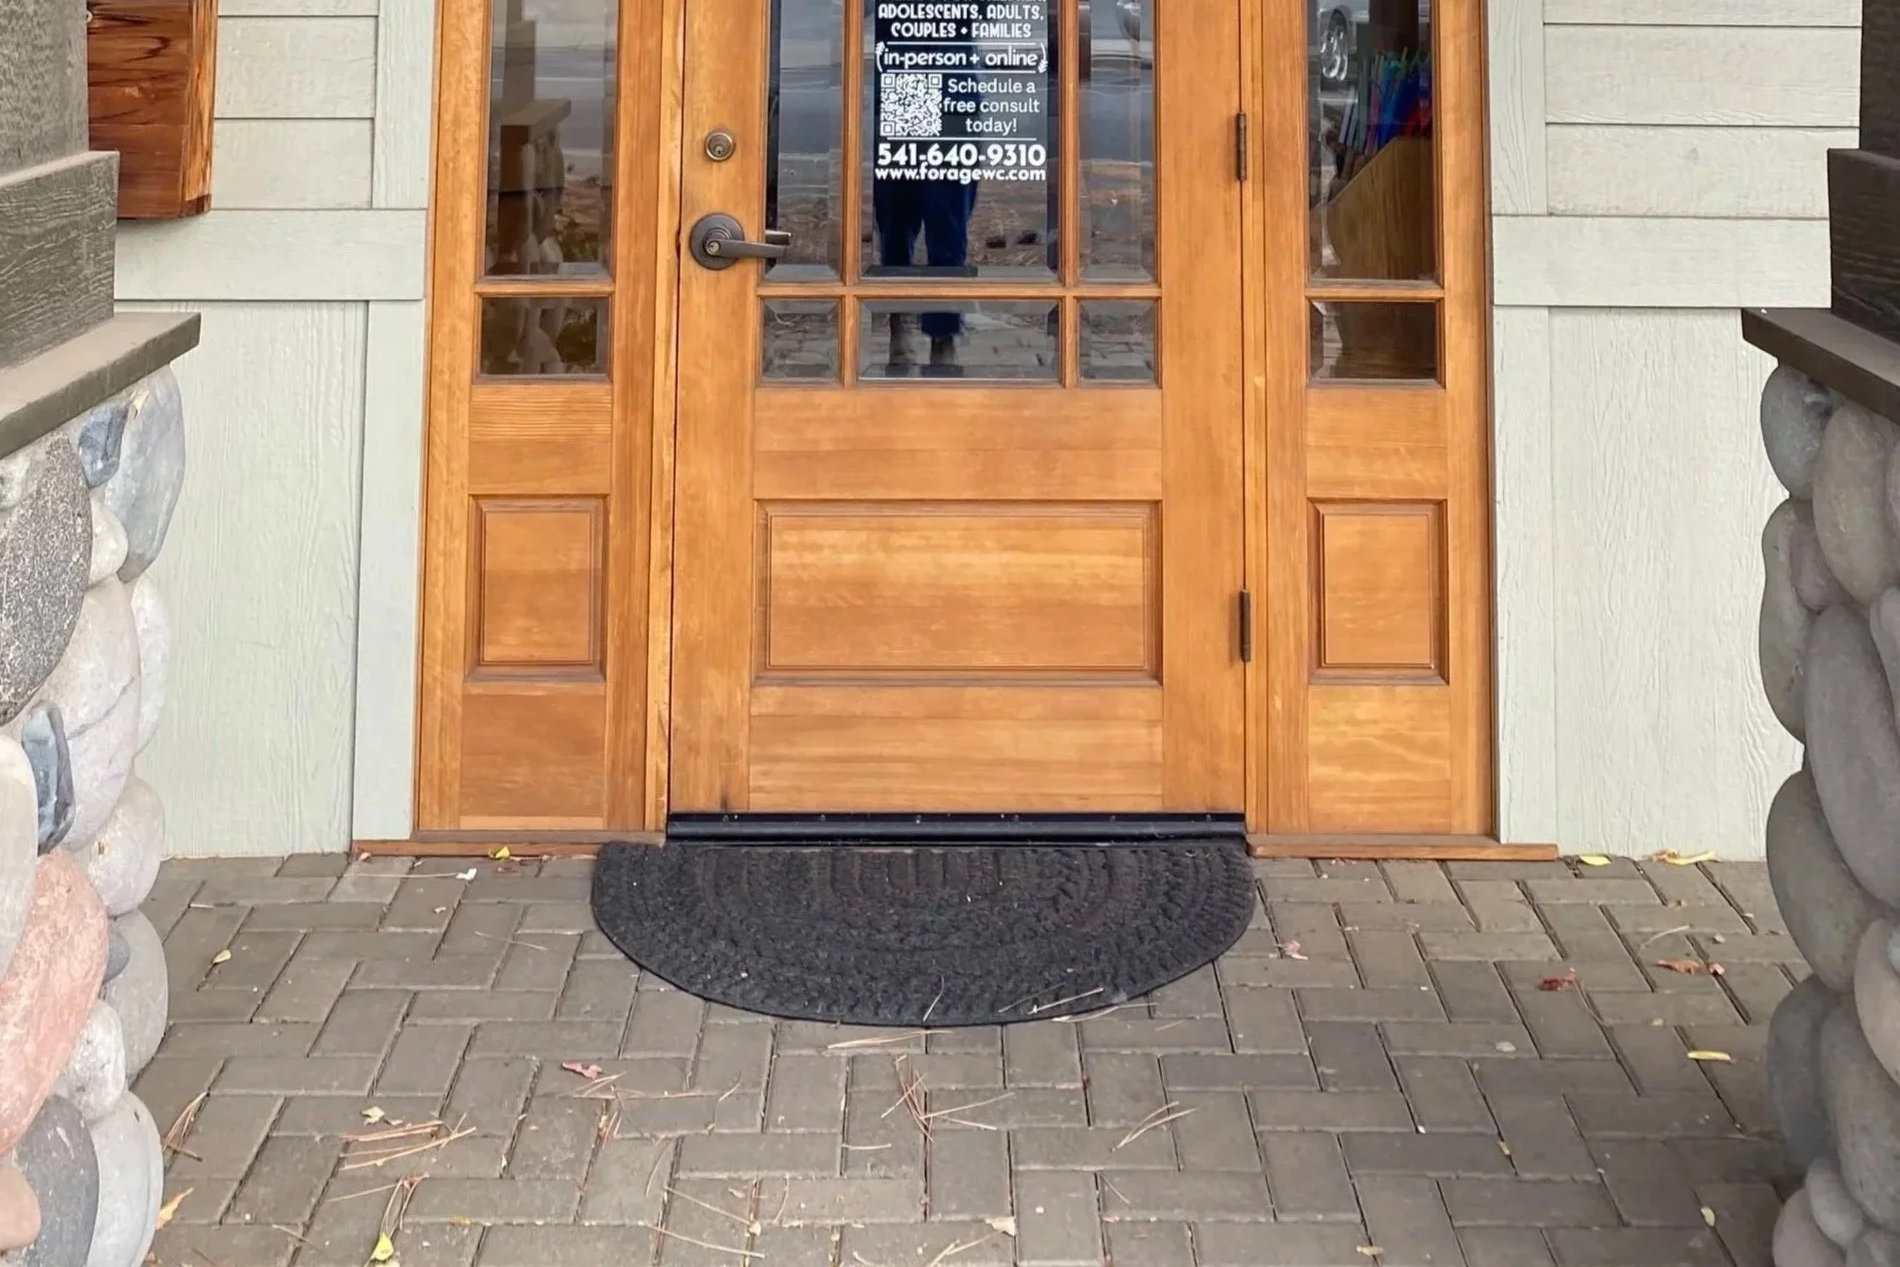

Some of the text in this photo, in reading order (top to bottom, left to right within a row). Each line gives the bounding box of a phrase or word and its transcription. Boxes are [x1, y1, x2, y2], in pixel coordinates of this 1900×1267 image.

[878, 4, 1044, 20] ADOLESCENTS, ADULTS,
[891, 22, 956, 37] COUPLES
[972, 23, 1031, 38] FAMILIES
[884, 48, 966, 68] in-person
[985, 46, 1038, 66] online
[948, 78, 1036, 94] Schedule a
[944, 98, 1039, 113] free consult
[966, 118, 1017, 136] today!
[878, 143, 1046, 166] 541-640-9310
[875, 162, 1046, 184] www.foragewc.com
